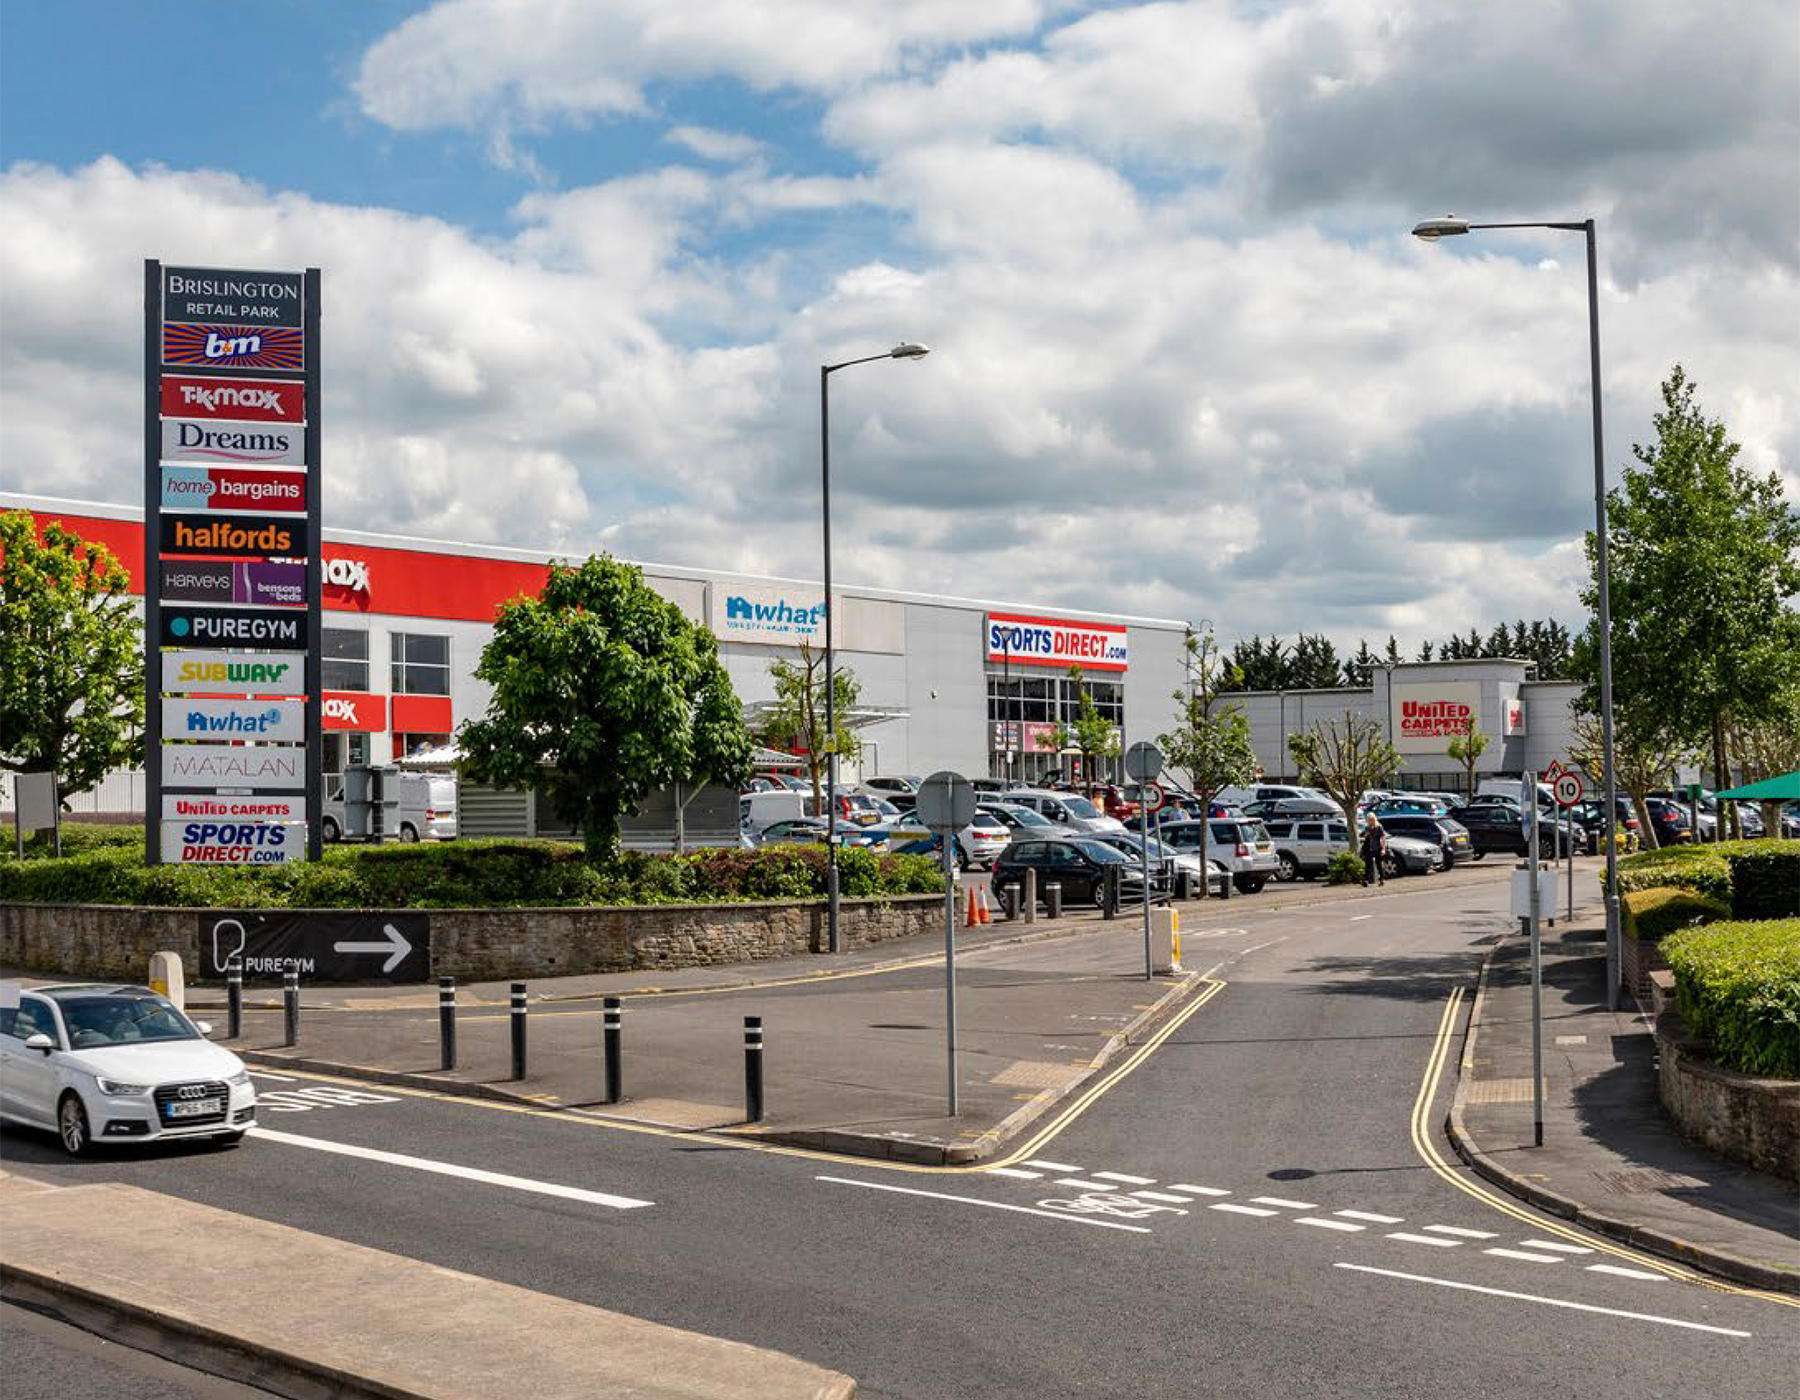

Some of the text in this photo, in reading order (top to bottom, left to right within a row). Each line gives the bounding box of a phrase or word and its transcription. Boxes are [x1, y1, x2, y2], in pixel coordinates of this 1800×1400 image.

[169, 275, 298, 300] BRISLINGTON
[186, 302, 279, 318] RETAIL PARK
[177, 422, 290, 452] Dreams
[167, 478, 300, 499] home bargains
[174, 521, 292, 549] halfords
[193, 617, 298, 639] PUREGYM
[178, 662, 288, 683] SUBWAY
[1402, 701, 1470, 717] UNITED
[1401, 718, 1470, 729] CARPETS
[172, 756, 296, 778] MATALAN
[1560, 784, 1576, 797] 10
[176, 800, 290, 816] UNITED CARPETS
[182, 824, 287, 845] SPORTS
